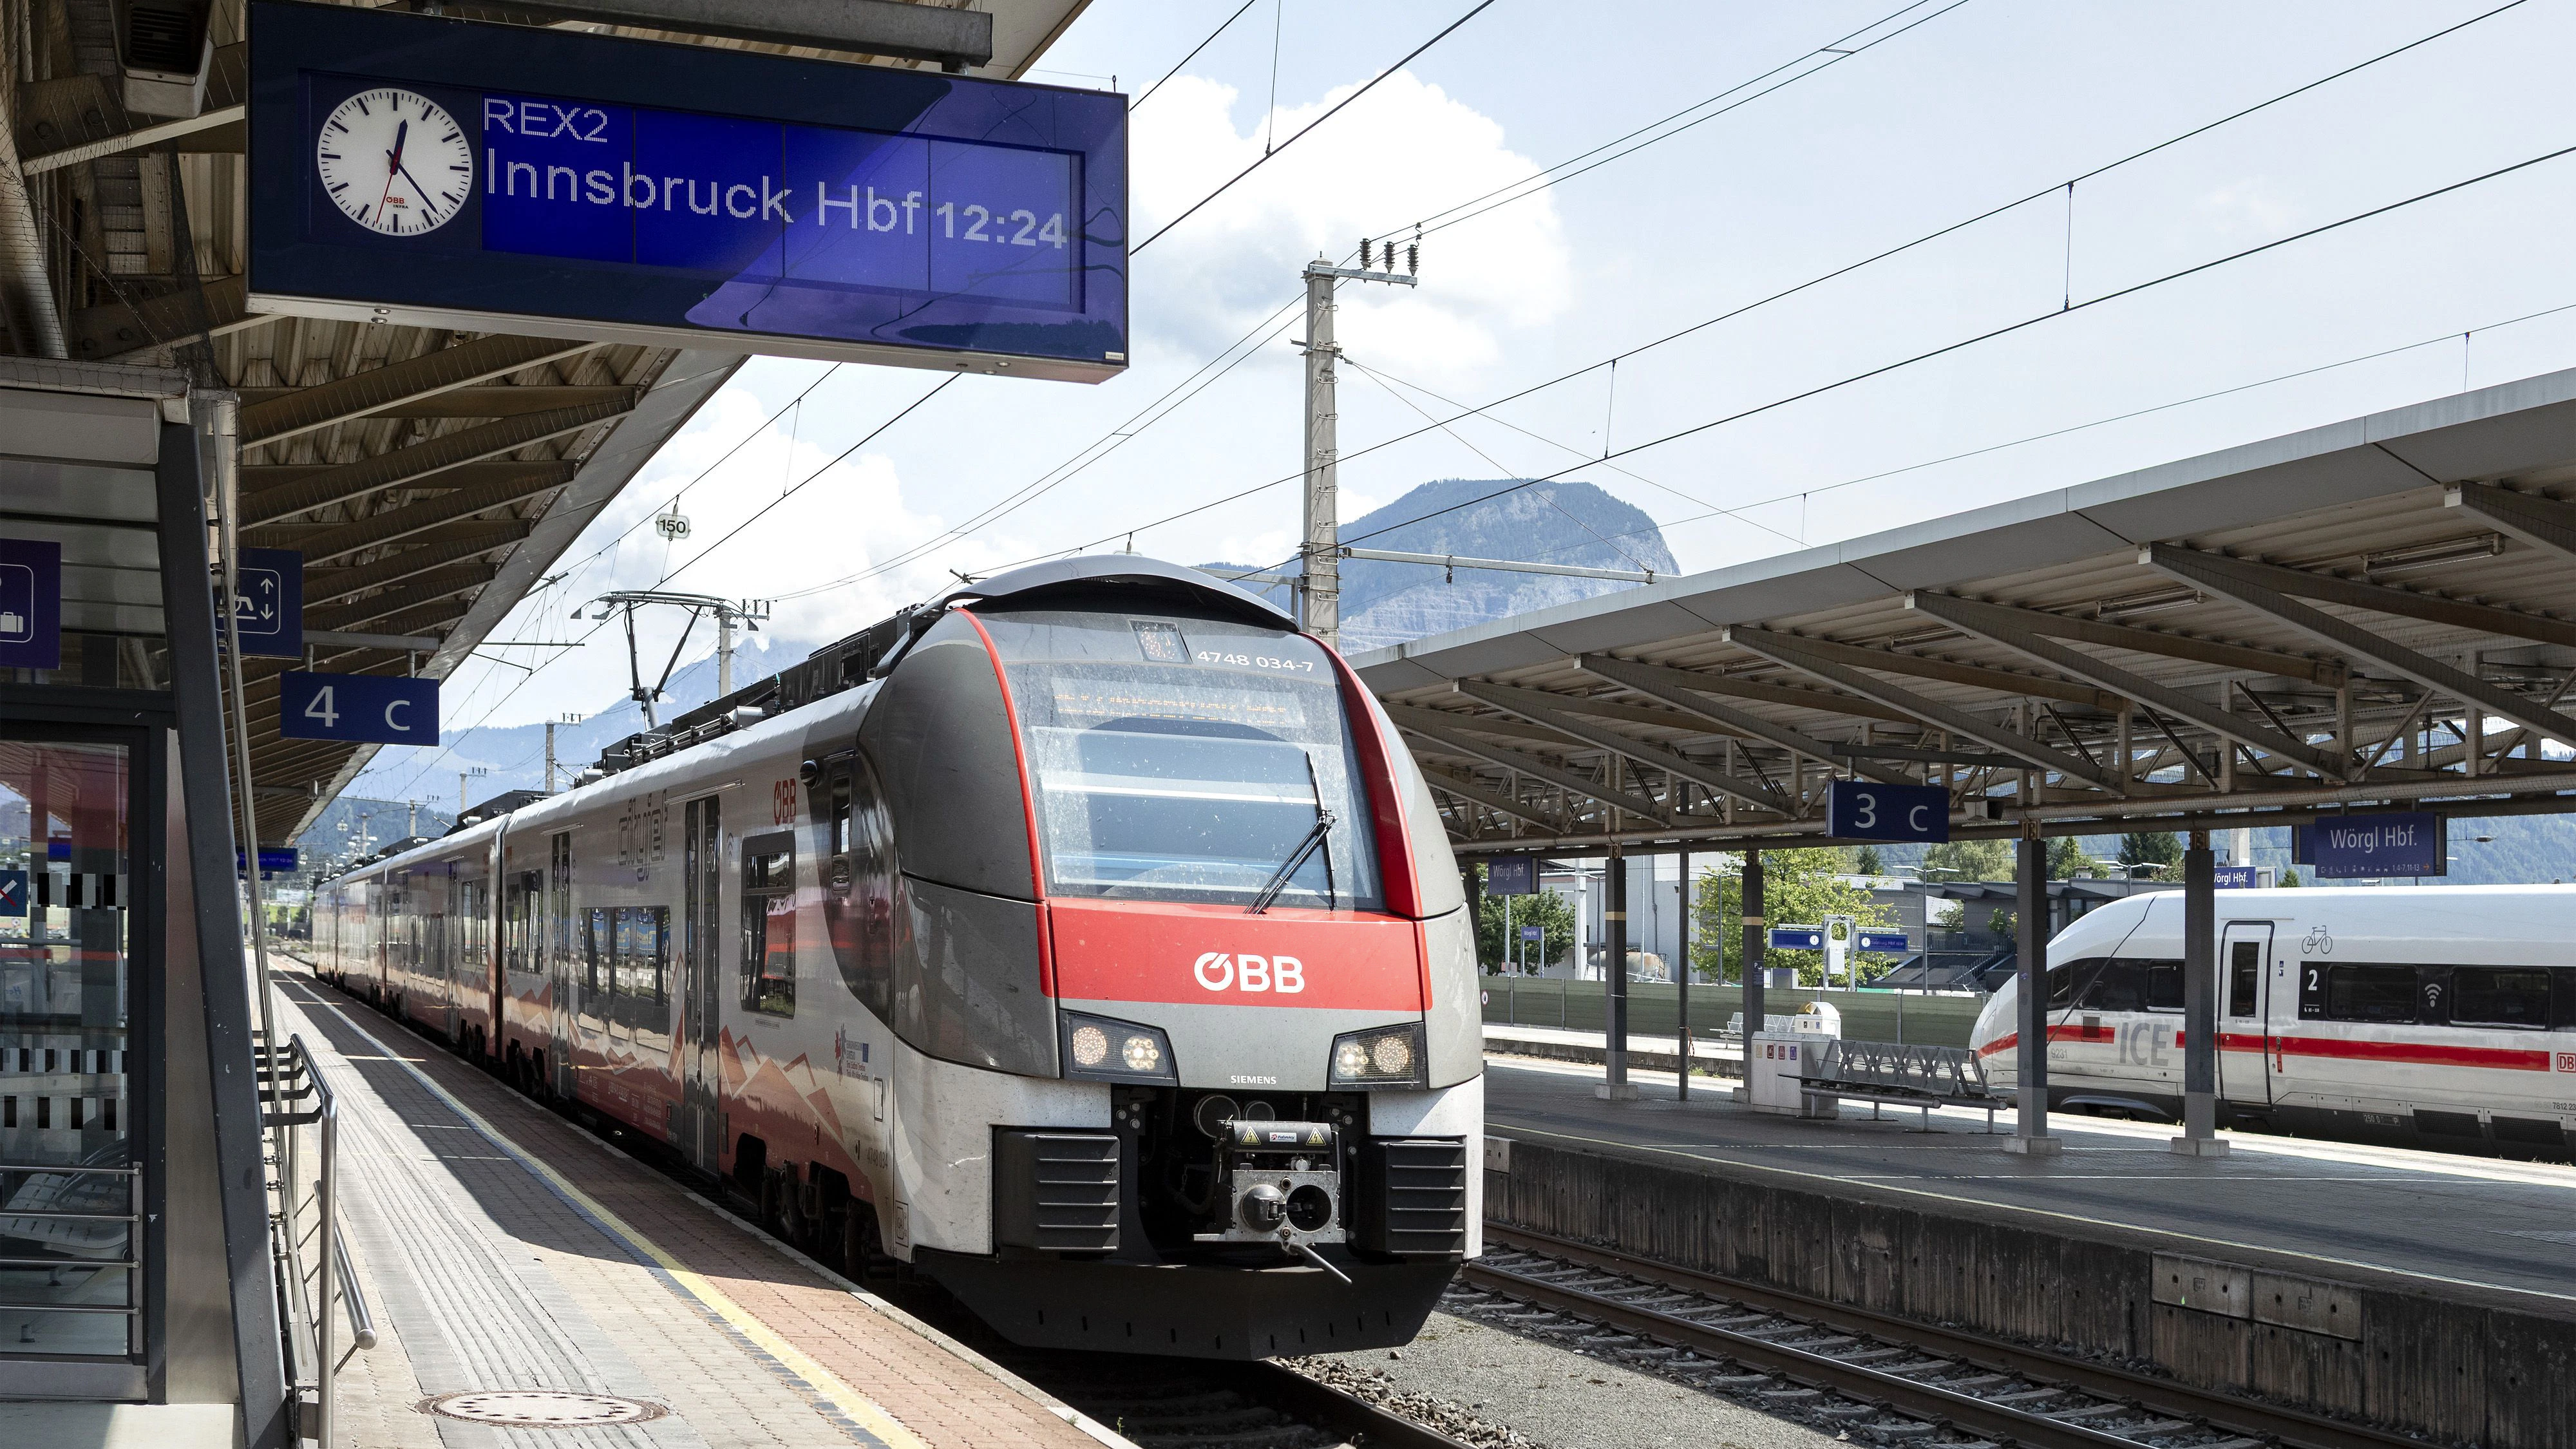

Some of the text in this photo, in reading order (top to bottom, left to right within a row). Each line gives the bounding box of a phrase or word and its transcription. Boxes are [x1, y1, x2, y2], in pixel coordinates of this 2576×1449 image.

[485, 99, 607, 142] REX2
[489, 148, 1067, 249] Innsbruck Hbf 12:24
[660, 519, 686, 533] 150
[1197, 651, 1313, 672] 4748 034-7
[305, 686, 339, 727] 4
[773, 778, 796, 826] ÖBB
[1855, 793, 1876, 828] 3
[618, 788, 668, 882] cityjet
[2330, 824, 2417, 853] Wörgl Hbf.
[1493, 864, 1525, 880] Wörgl Hbf.
[2214, 872, 2231, 885] örgl
[1194, 952, 1305, 994] ÖBB
[2308, 969, 2318, 990] 2
[2051, 1048, 2068, 1059] 9231
[2119, 1022, 2172, 1067] ICE
[2559, 1056, 2575, 1070] DB
[1231, 1075, 1277, 1084] SIEMENS
[2552, 1102, 2567, 1110] 7812
